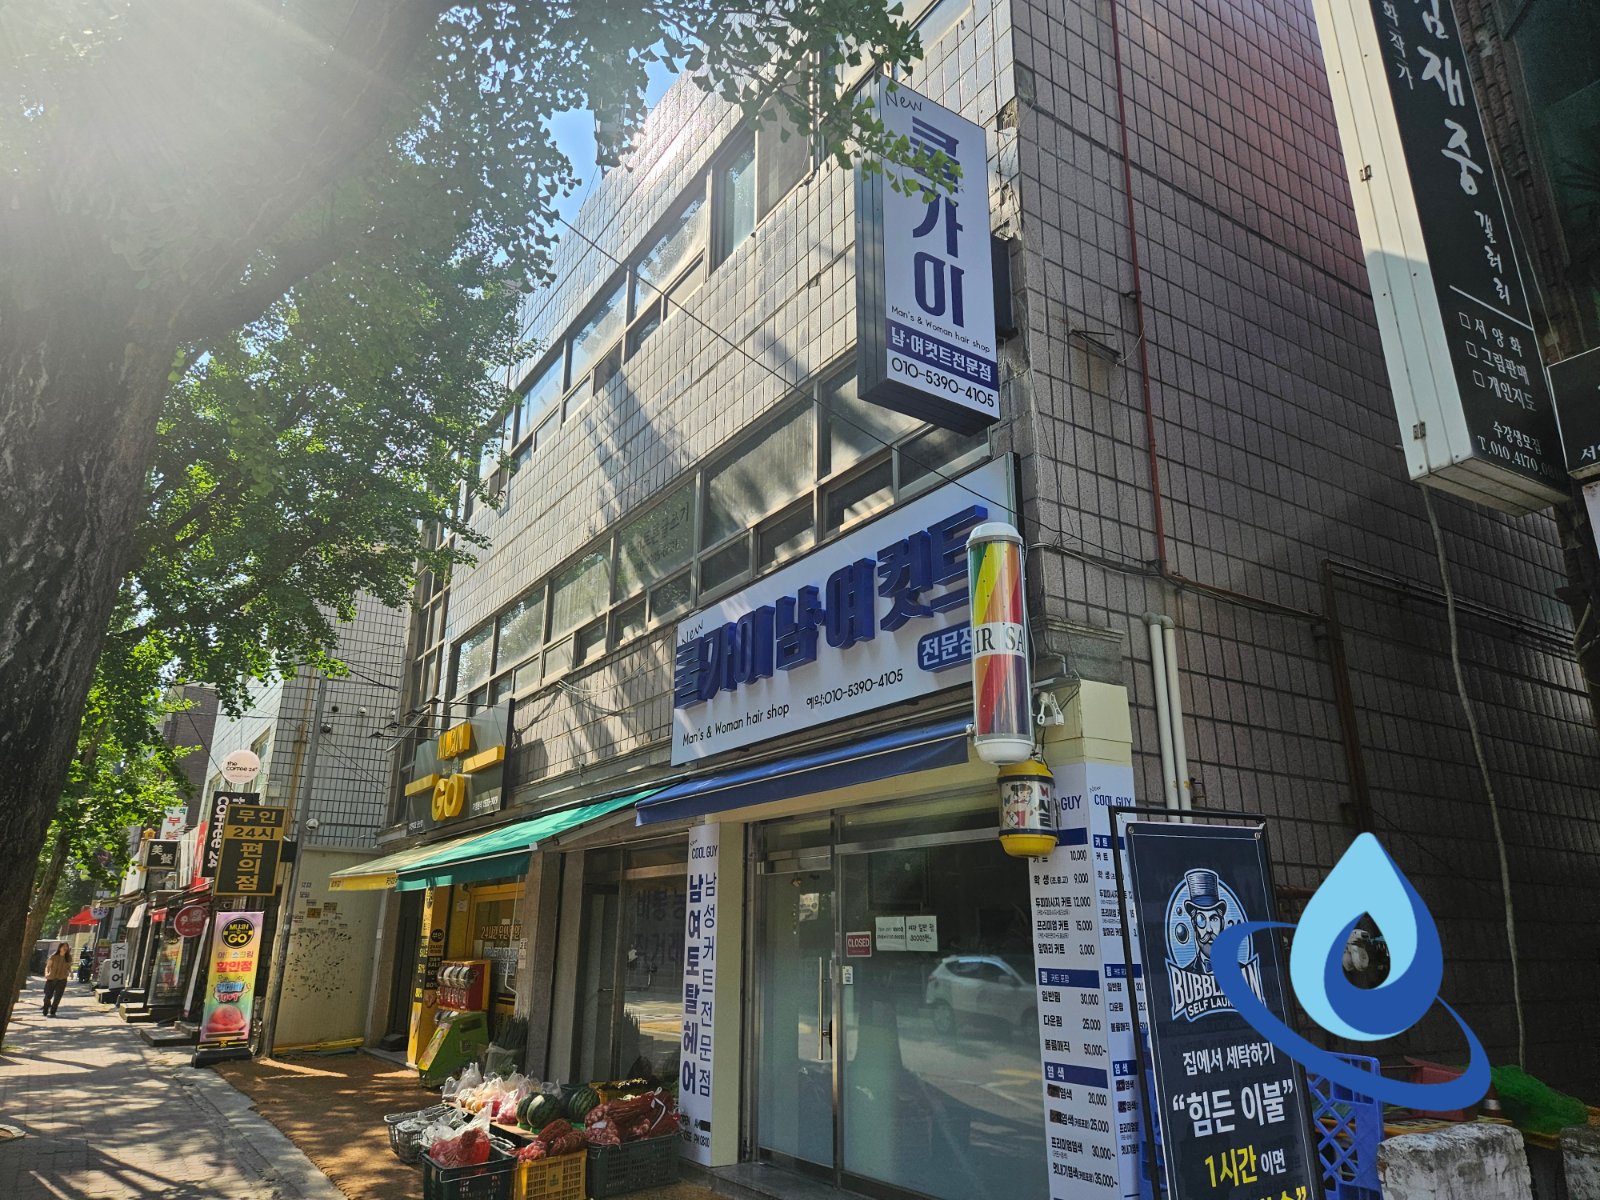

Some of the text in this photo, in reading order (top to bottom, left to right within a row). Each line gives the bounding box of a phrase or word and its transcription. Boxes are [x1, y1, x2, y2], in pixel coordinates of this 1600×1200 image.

[891, 305, 992, 355] Man's & Woman hair shop
[1481, 346, 1530, 387] 그림판매
[891, 356, 995, 409] 010-5390-4105
[1488, 375, 1537, 412] 개인지도
[1493, 420, 1543, 456] 수강생모집
[806, 667, 904, 711] 예약:010-5390-4105
[682, 702, 790, 747] Man's & Woman hair shop
[431, 773, 466, 822] GO
[1061, 794, 1082, 811] GUY
[1094, 794, 1132, 806] COOL GUY
[237, 810, 277, 824] 무인
[233, 827, 275, 840] 24시
[692, 844, 718, 859] COOL GUY
[1070, 849, 1087, 863] 10,000
[235, 842, 264, 892] 편의점
[1073, 873, 1089, 885] 9,000
[1061, 896, 1072, 907] 커트
[1072, 896, 1091, 908] 12,000
[1037, 920, 1058, 932] 프리미엄
[1058, 919, 1070, 931] 커트
[1075, 920, 1093, 933] 15,000
[228, 933, 247, 943] GO
[848, 938, 870, 948] CLOSED
[1054, 943, 1066, 955] 커트
[1079, 943, 1095, 957] 3,000
[111, 959, 125, 985] 헤어
[216, 960, 252, 973] 할인점
[699, 872, 717, 1098] 남성커트전문점
[1041, 990, 1099, 1006] 일반펌 30,000
[1188, 1002, 1208, 1017] SELF
[1043, 1014, 1101, 1031] 다운펌 25,000
[1183, 1042, 1276, 1076] 집에서 세탁하기
[1088, 1091, 1107, 1107] 20,000
[1089, 1118, 1110, 1134] 25,000
[1204, 1143, 1287, 1190] 1시간 이면
